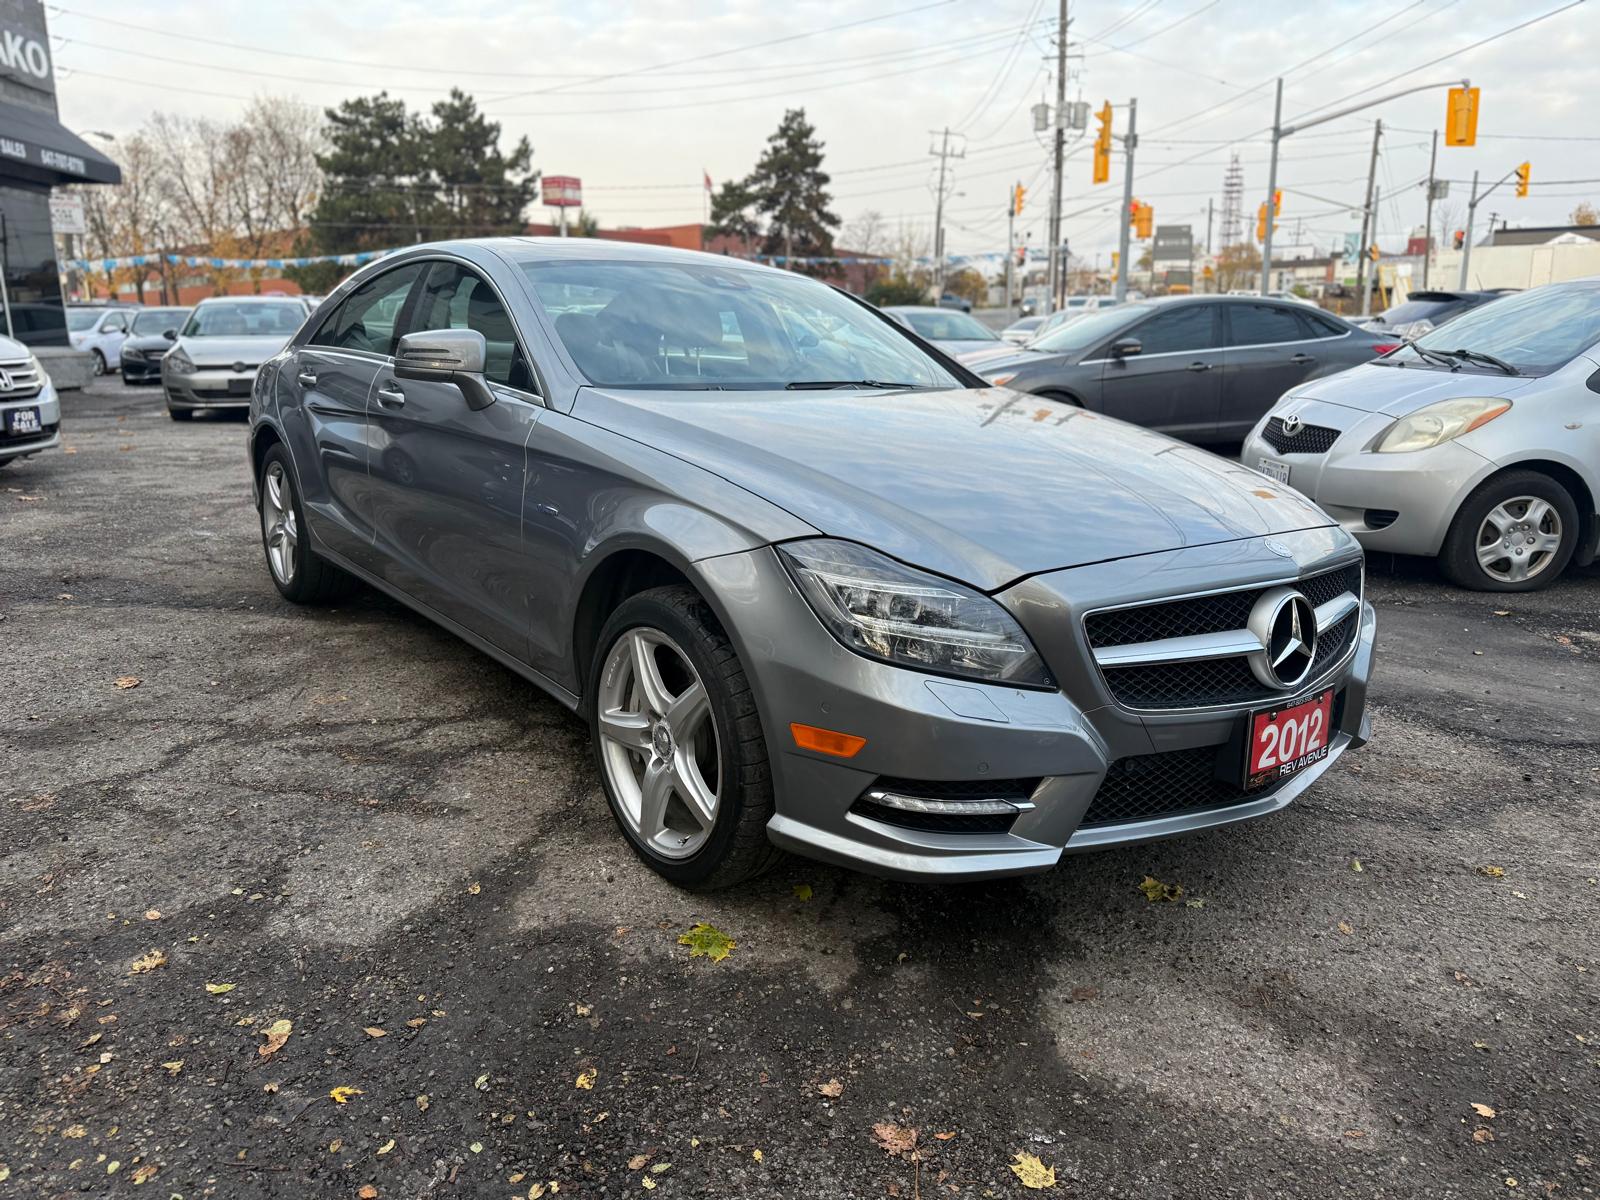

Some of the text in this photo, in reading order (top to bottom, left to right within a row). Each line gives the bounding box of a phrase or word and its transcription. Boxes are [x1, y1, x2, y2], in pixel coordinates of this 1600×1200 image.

[0, 138, 26, 159] SALES
[12, 420, 38, 431] SALE
[14, 411, 35, 421] FOR
[1257, 708, 1323, 769] 2012
[1279, 745, 1328, 776] REV AVENUE
